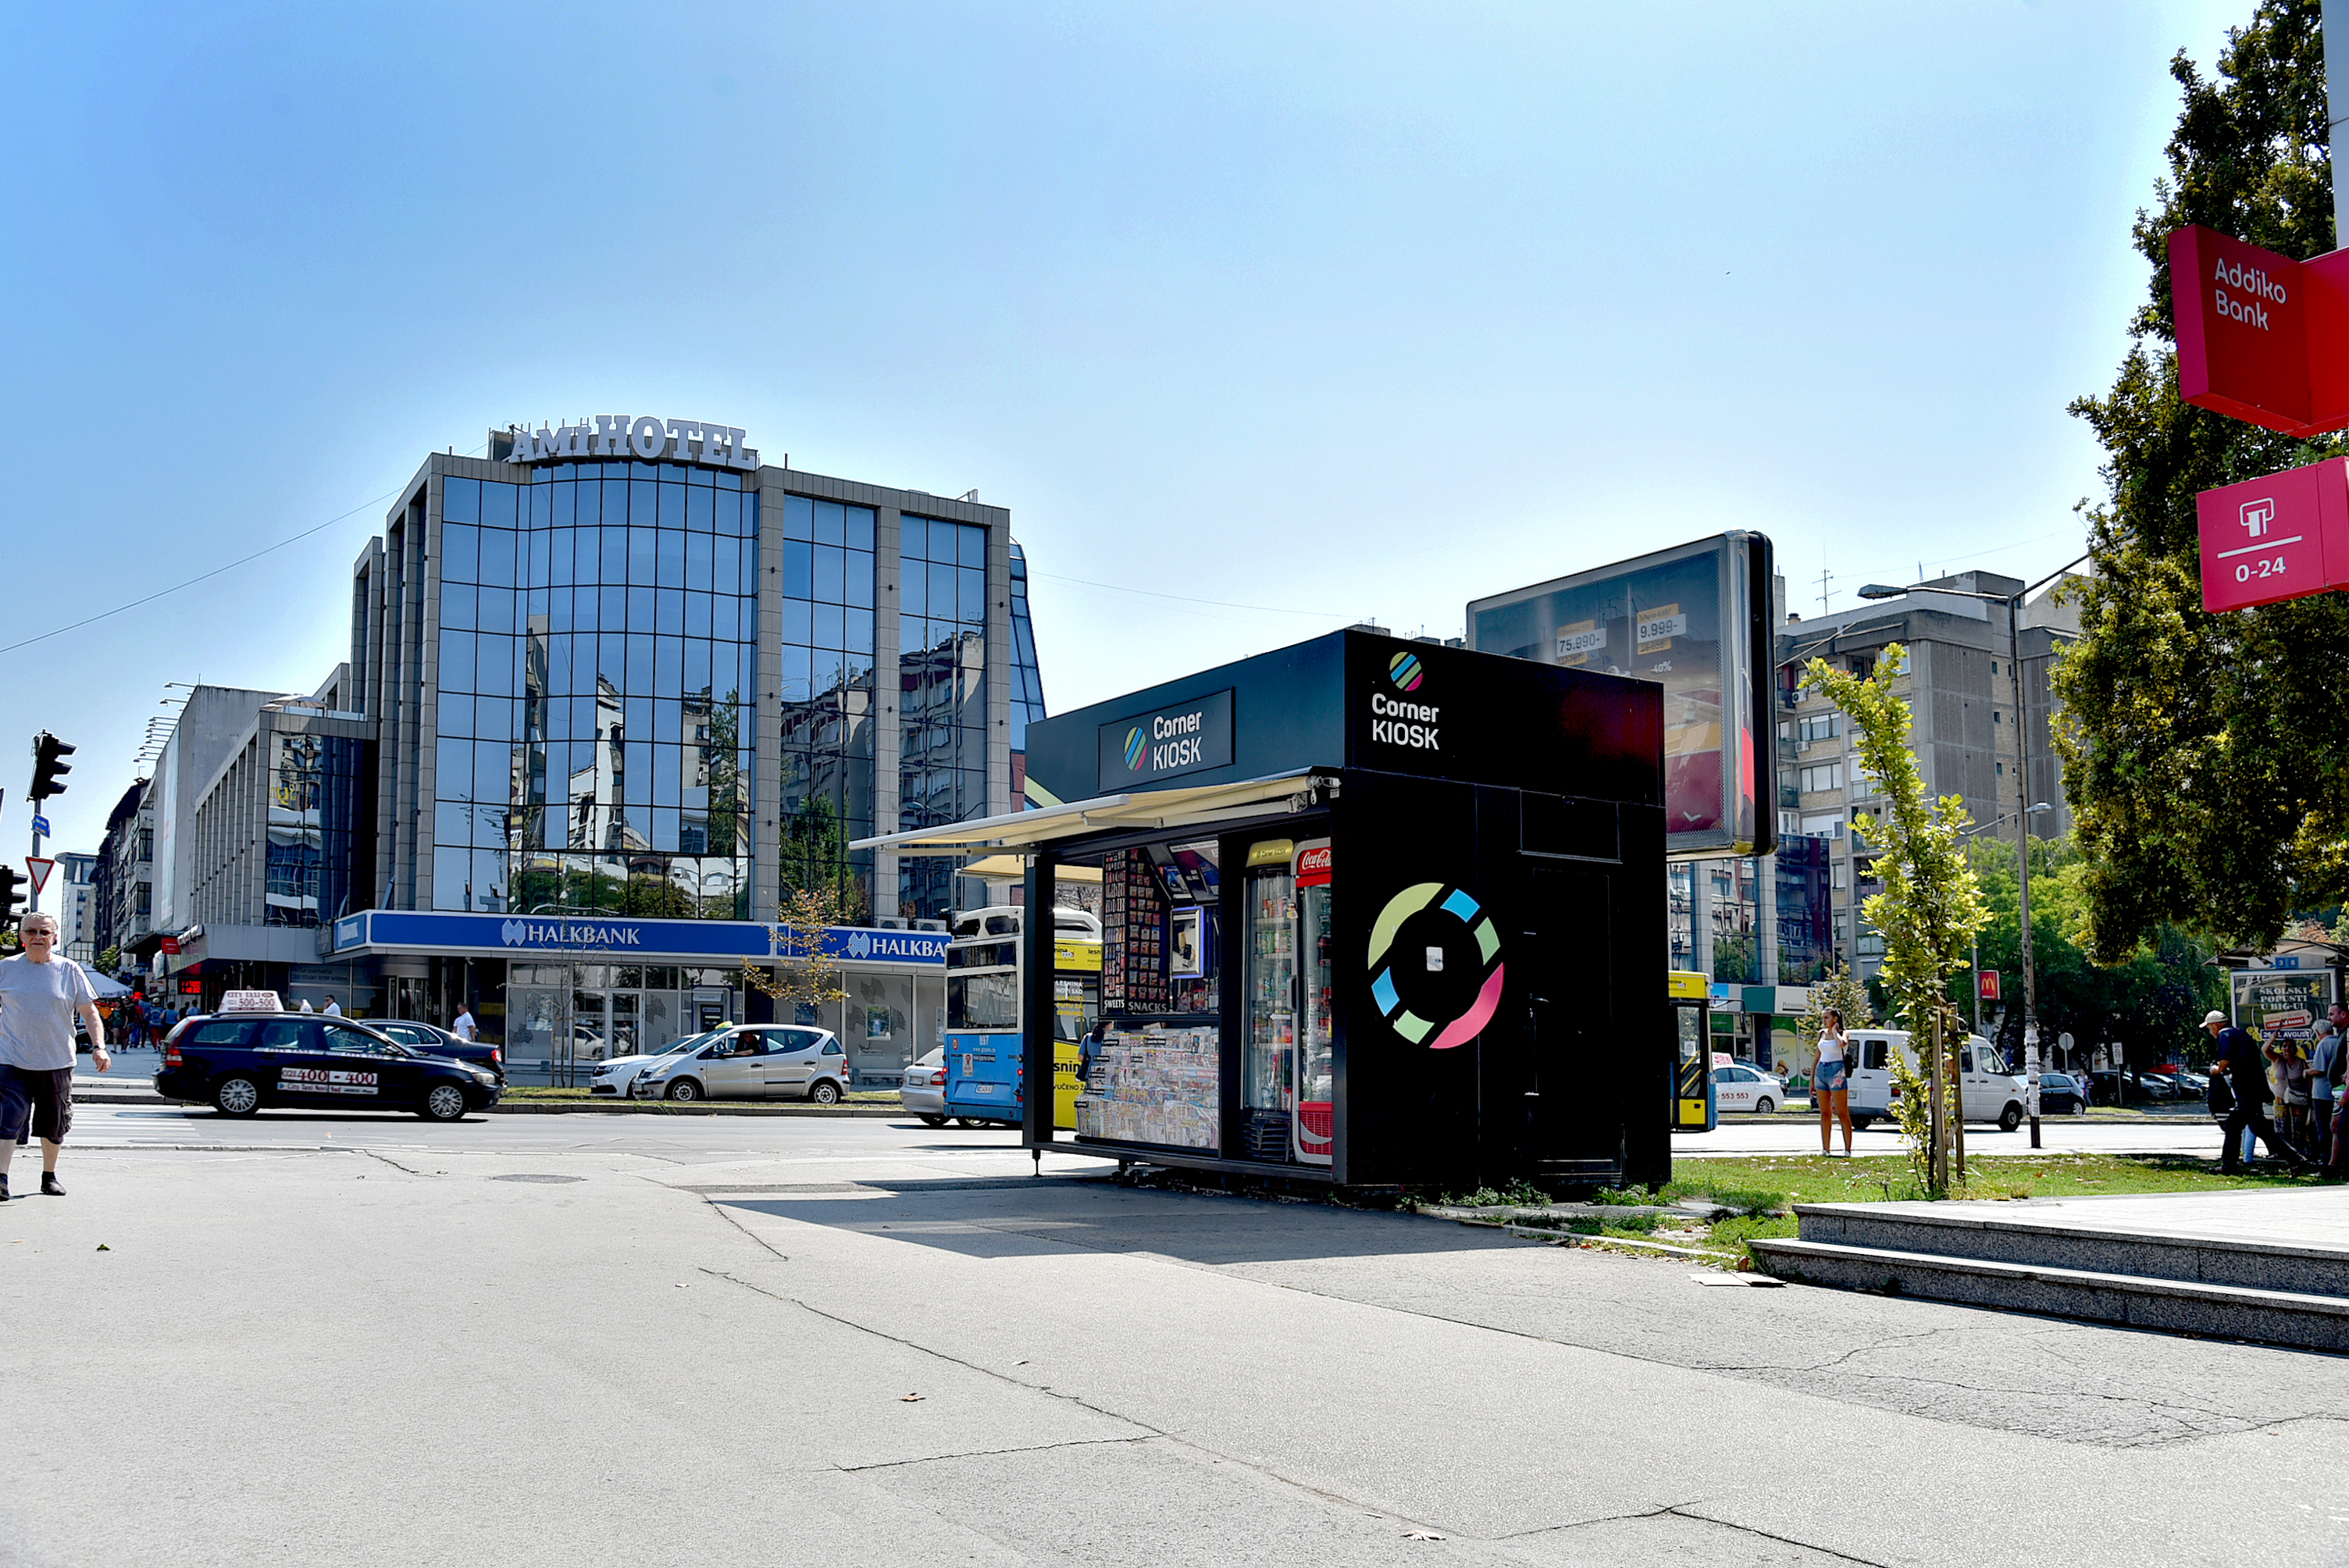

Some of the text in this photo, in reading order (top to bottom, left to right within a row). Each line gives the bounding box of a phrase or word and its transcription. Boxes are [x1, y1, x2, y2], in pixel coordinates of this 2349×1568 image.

[2215, 258, 2287, 304] Addiko
[2215, 289, 2269, 331] Bank
[510, 415, 756, 471] AMI HOTEL
[2235, 557, 2287, 583] 0-24
[1641, 620, 1678, 638] 9.999-
[1559, 633, 1600, 653] 75.990-
[1650, 661, 1673, 673] -40%
[1372, 693, 1439, 723] Corner
[1153, 711, 1203, 740] Corner
[1372, 719, 1439, 750] KIOSK
[1153, 736, 1202, 772] KIOSK
[529, 925, 640, 945] HALKBANK
[872, 938, 945, 957] HALKBA
[239, 998, 274, 1007] 500-500
[1104, 1000, 1167, 1013] SWEETS SNACKS
[2270, 1002, 2304, 1010] BIG-U!
[979, 1035, 989, 1046] 897
[1053, 1060, 1081, 1072] snin
[298, 1069, 328, 1082] 400
[346, 1072, 375, 1084] 400
